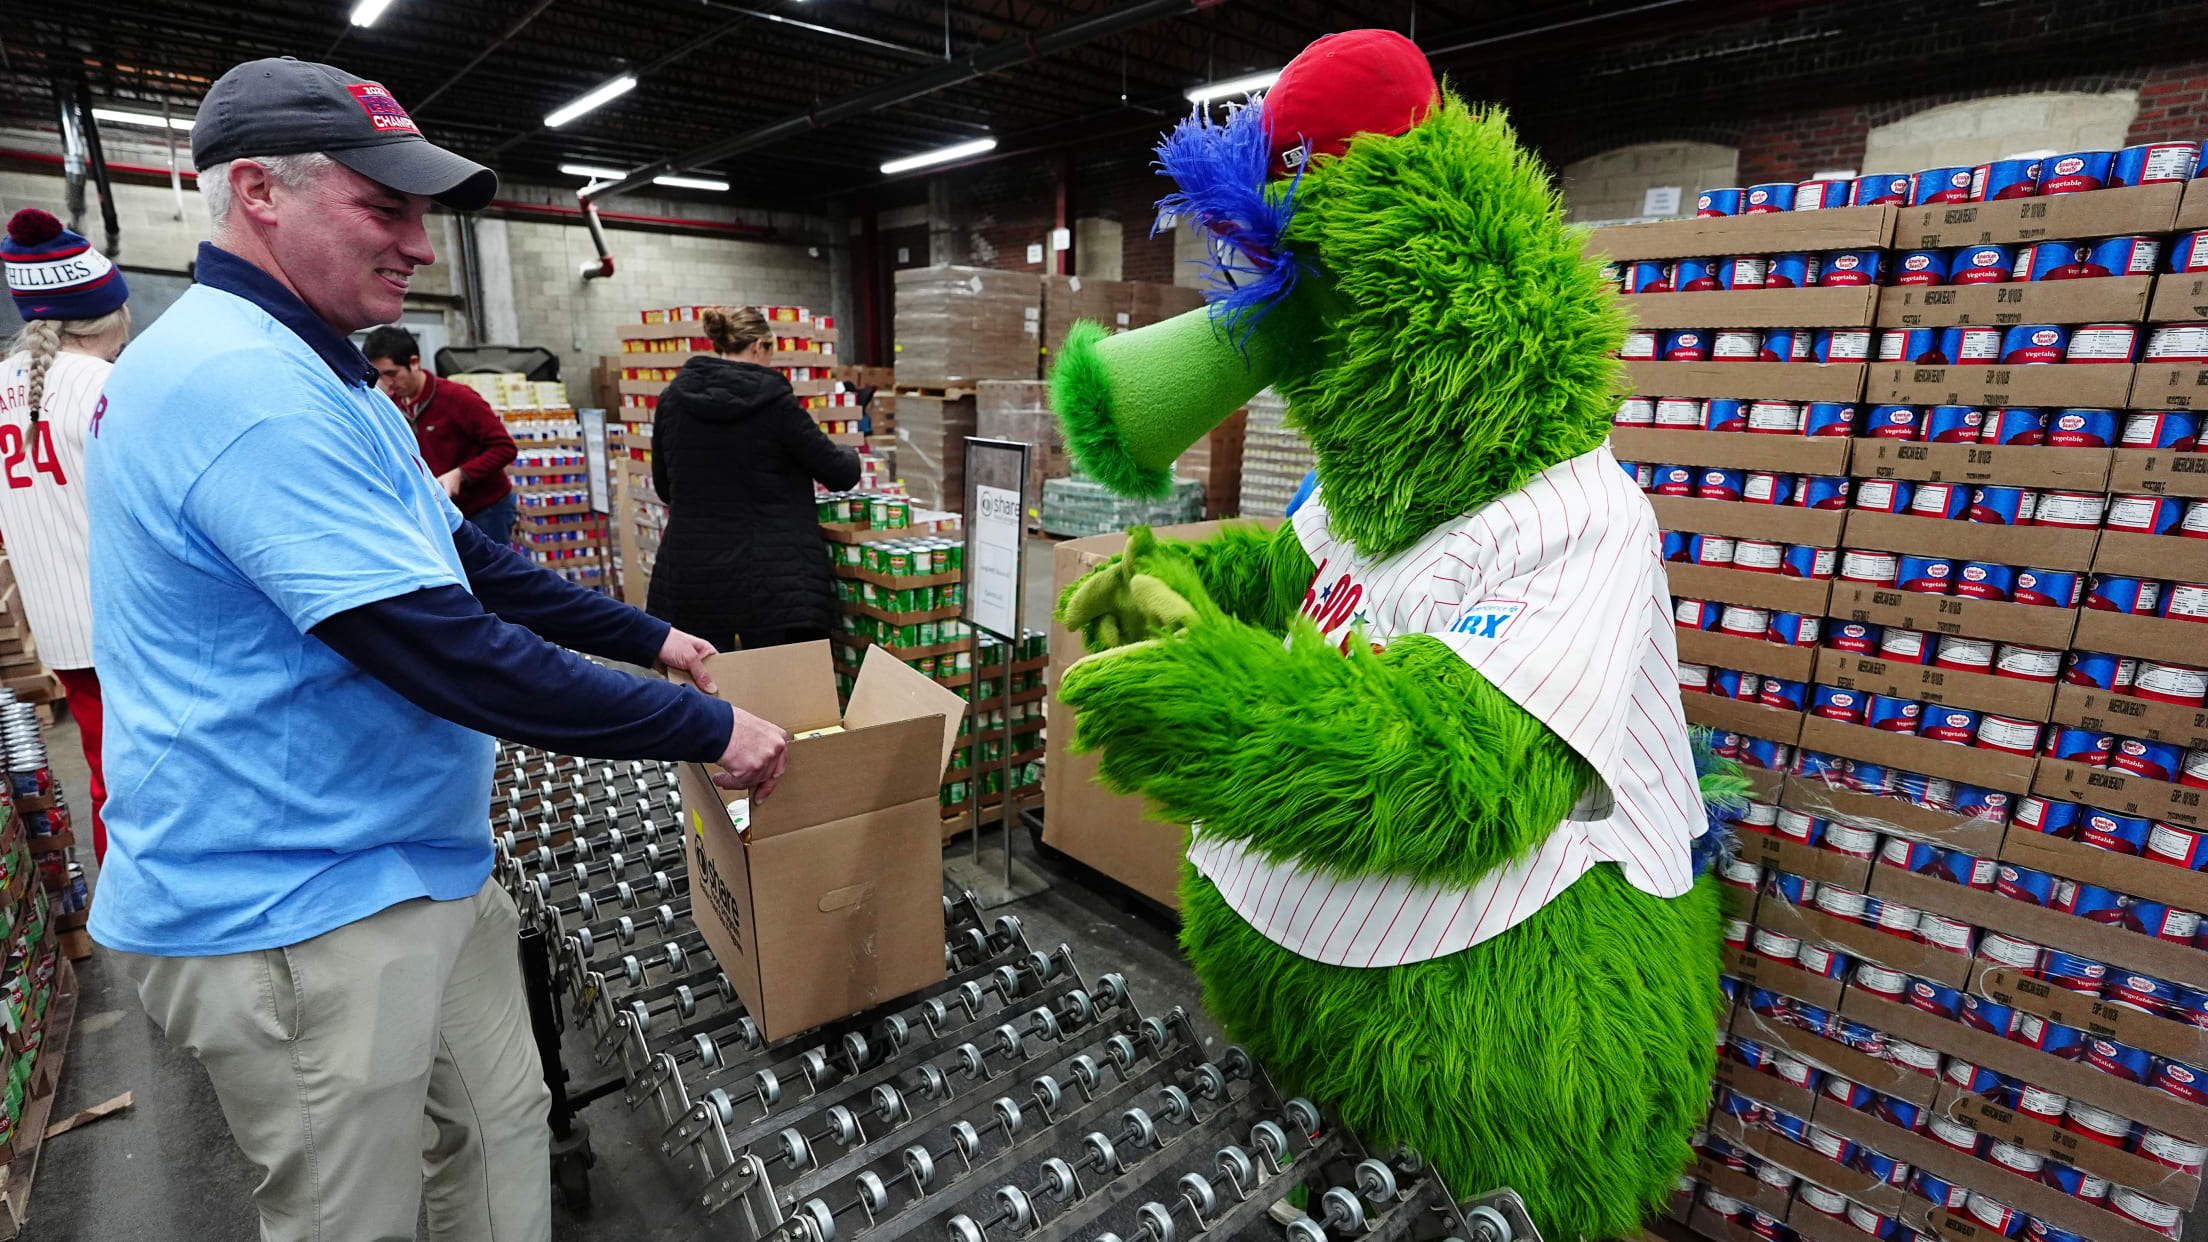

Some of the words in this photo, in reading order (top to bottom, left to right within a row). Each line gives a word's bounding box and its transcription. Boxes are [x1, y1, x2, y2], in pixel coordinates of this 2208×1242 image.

[2049, 180, 2081, 188] Vegetable
[0, 420, 67, 489] 24
[1958, 584, 1985, 592] Vegetable
[1839, 640, 1865, 648] Vegetable
[2115, 757, 2144, 768] Vegetable
[2085, 832, 2115, 845] Vegetable
[708, 857, 740, 927] share
[2087, 1052, 2115, 1069] Vegetable
[2160, 1077, 2192, 1096] Vegetable
